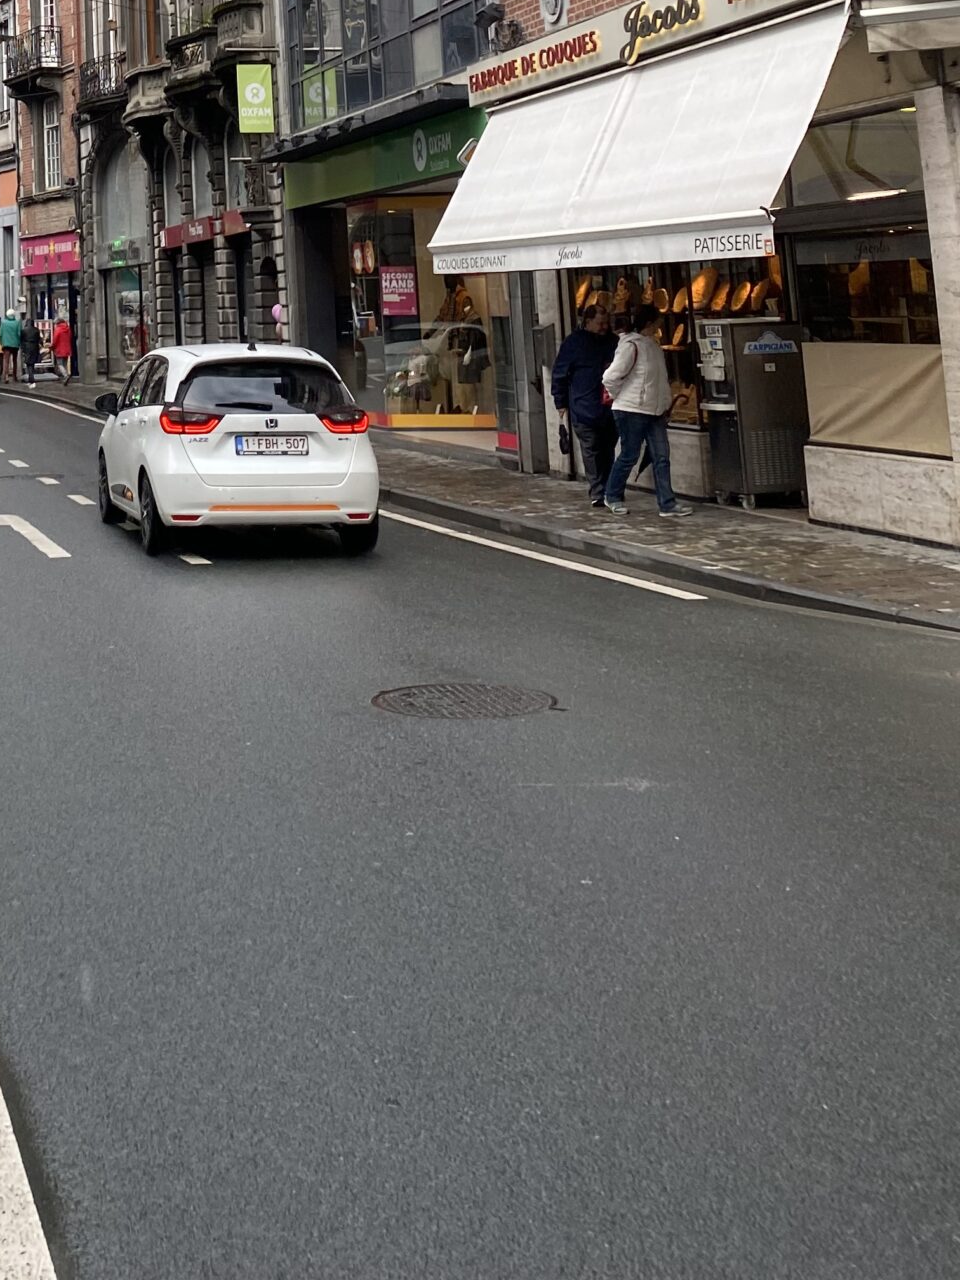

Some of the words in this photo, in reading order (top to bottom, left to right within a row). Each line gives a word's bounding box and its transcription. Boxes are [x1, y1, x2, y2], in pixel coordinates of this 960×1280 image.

[469, 57, 519, 93] FABRIQUE
[521, 52, 537, 76] DE
[538, 31, 598, 70] COUQUES
[241, 107, 272, 118] OXFAM
[428, 131, 452, 155] OXFAM
[693, 233, 764, 256] PATISSERIE
[437, 256, 469, 271] COUQUES
[470, 257, 480, 269] DE
[480, 254, 507, 269] DINANT
[556, 245, 583, 267] Jacobs
[381, 272, 414, 280] SECOND
[382, 279, 414, 289] HAND
[747, 342, 793, 352] CARPIGIANI
